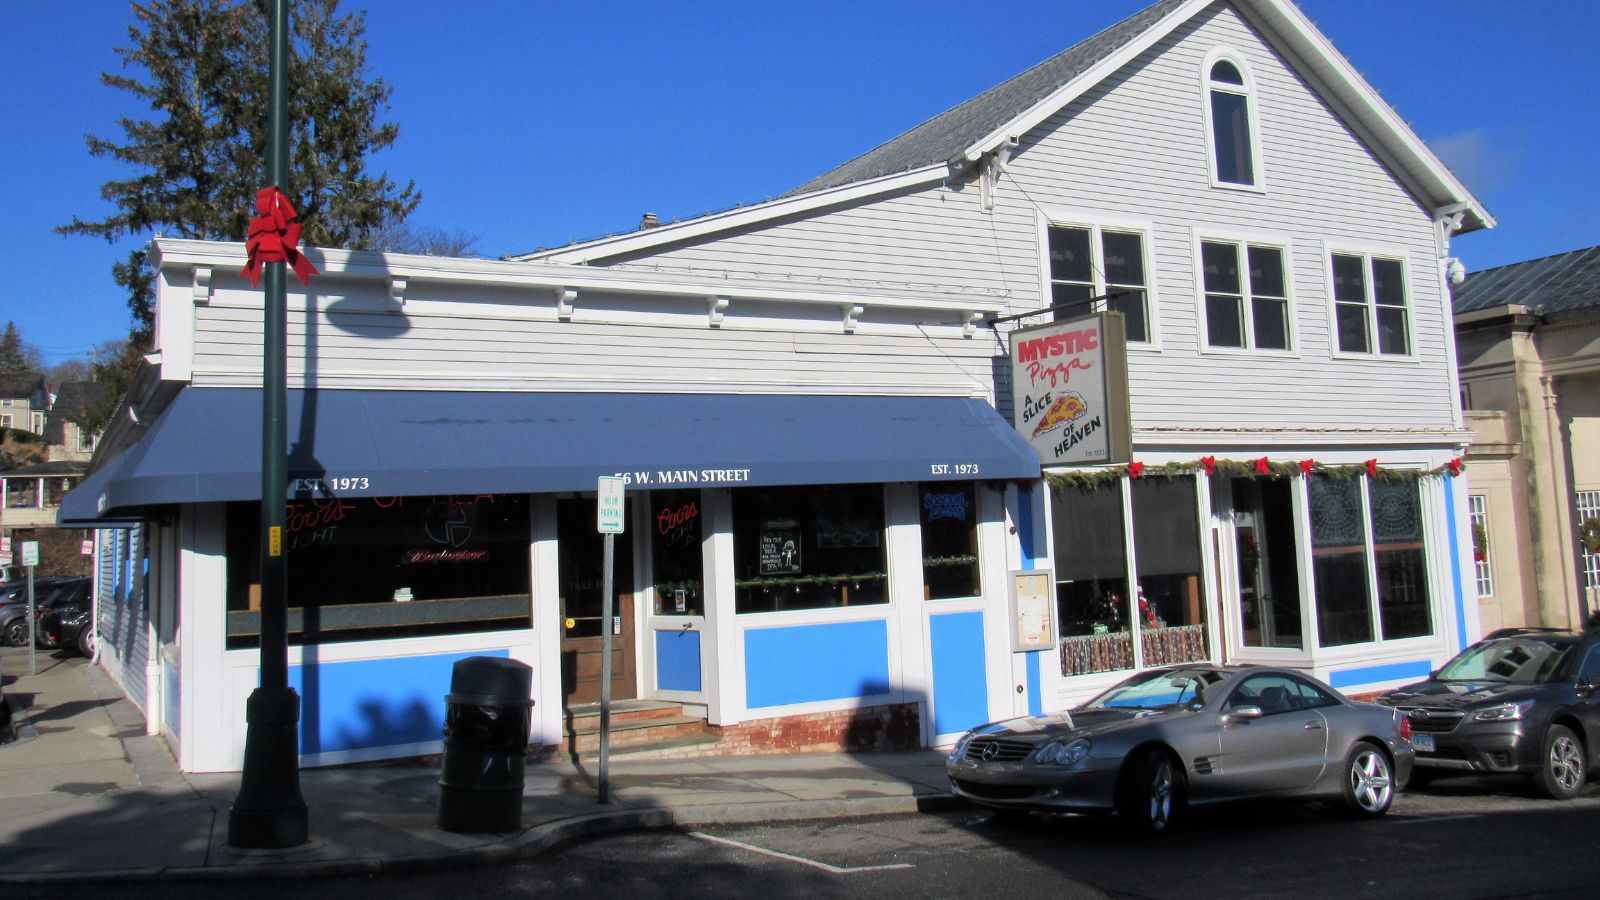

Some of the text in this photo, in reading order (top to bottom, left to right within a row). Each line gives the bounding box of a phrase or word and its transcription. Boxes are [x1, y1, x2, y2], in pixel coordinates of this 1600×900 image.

[1017, 328, 1098, 363] MYSTIC
[1025, 357, 1092, 388] Pizza
[1022, 391, 1053, 423] SLICE
[1024, 394, 1033, 408] A
[1053, 415, 1101, 458] HEAVEN
[1063, 423, 1075, 438] OF
[634, 471, 654, 484] W.
[658, 470, 698, 483] MAIN
[701, 469, 750, 482] STREET
[930, 464, 979, 475] EST. 1973
[294, 477, 370, 491] EST. 1973
[600, 508, 622, 518] PARKING
[656, 501, 700, 535] Coors
